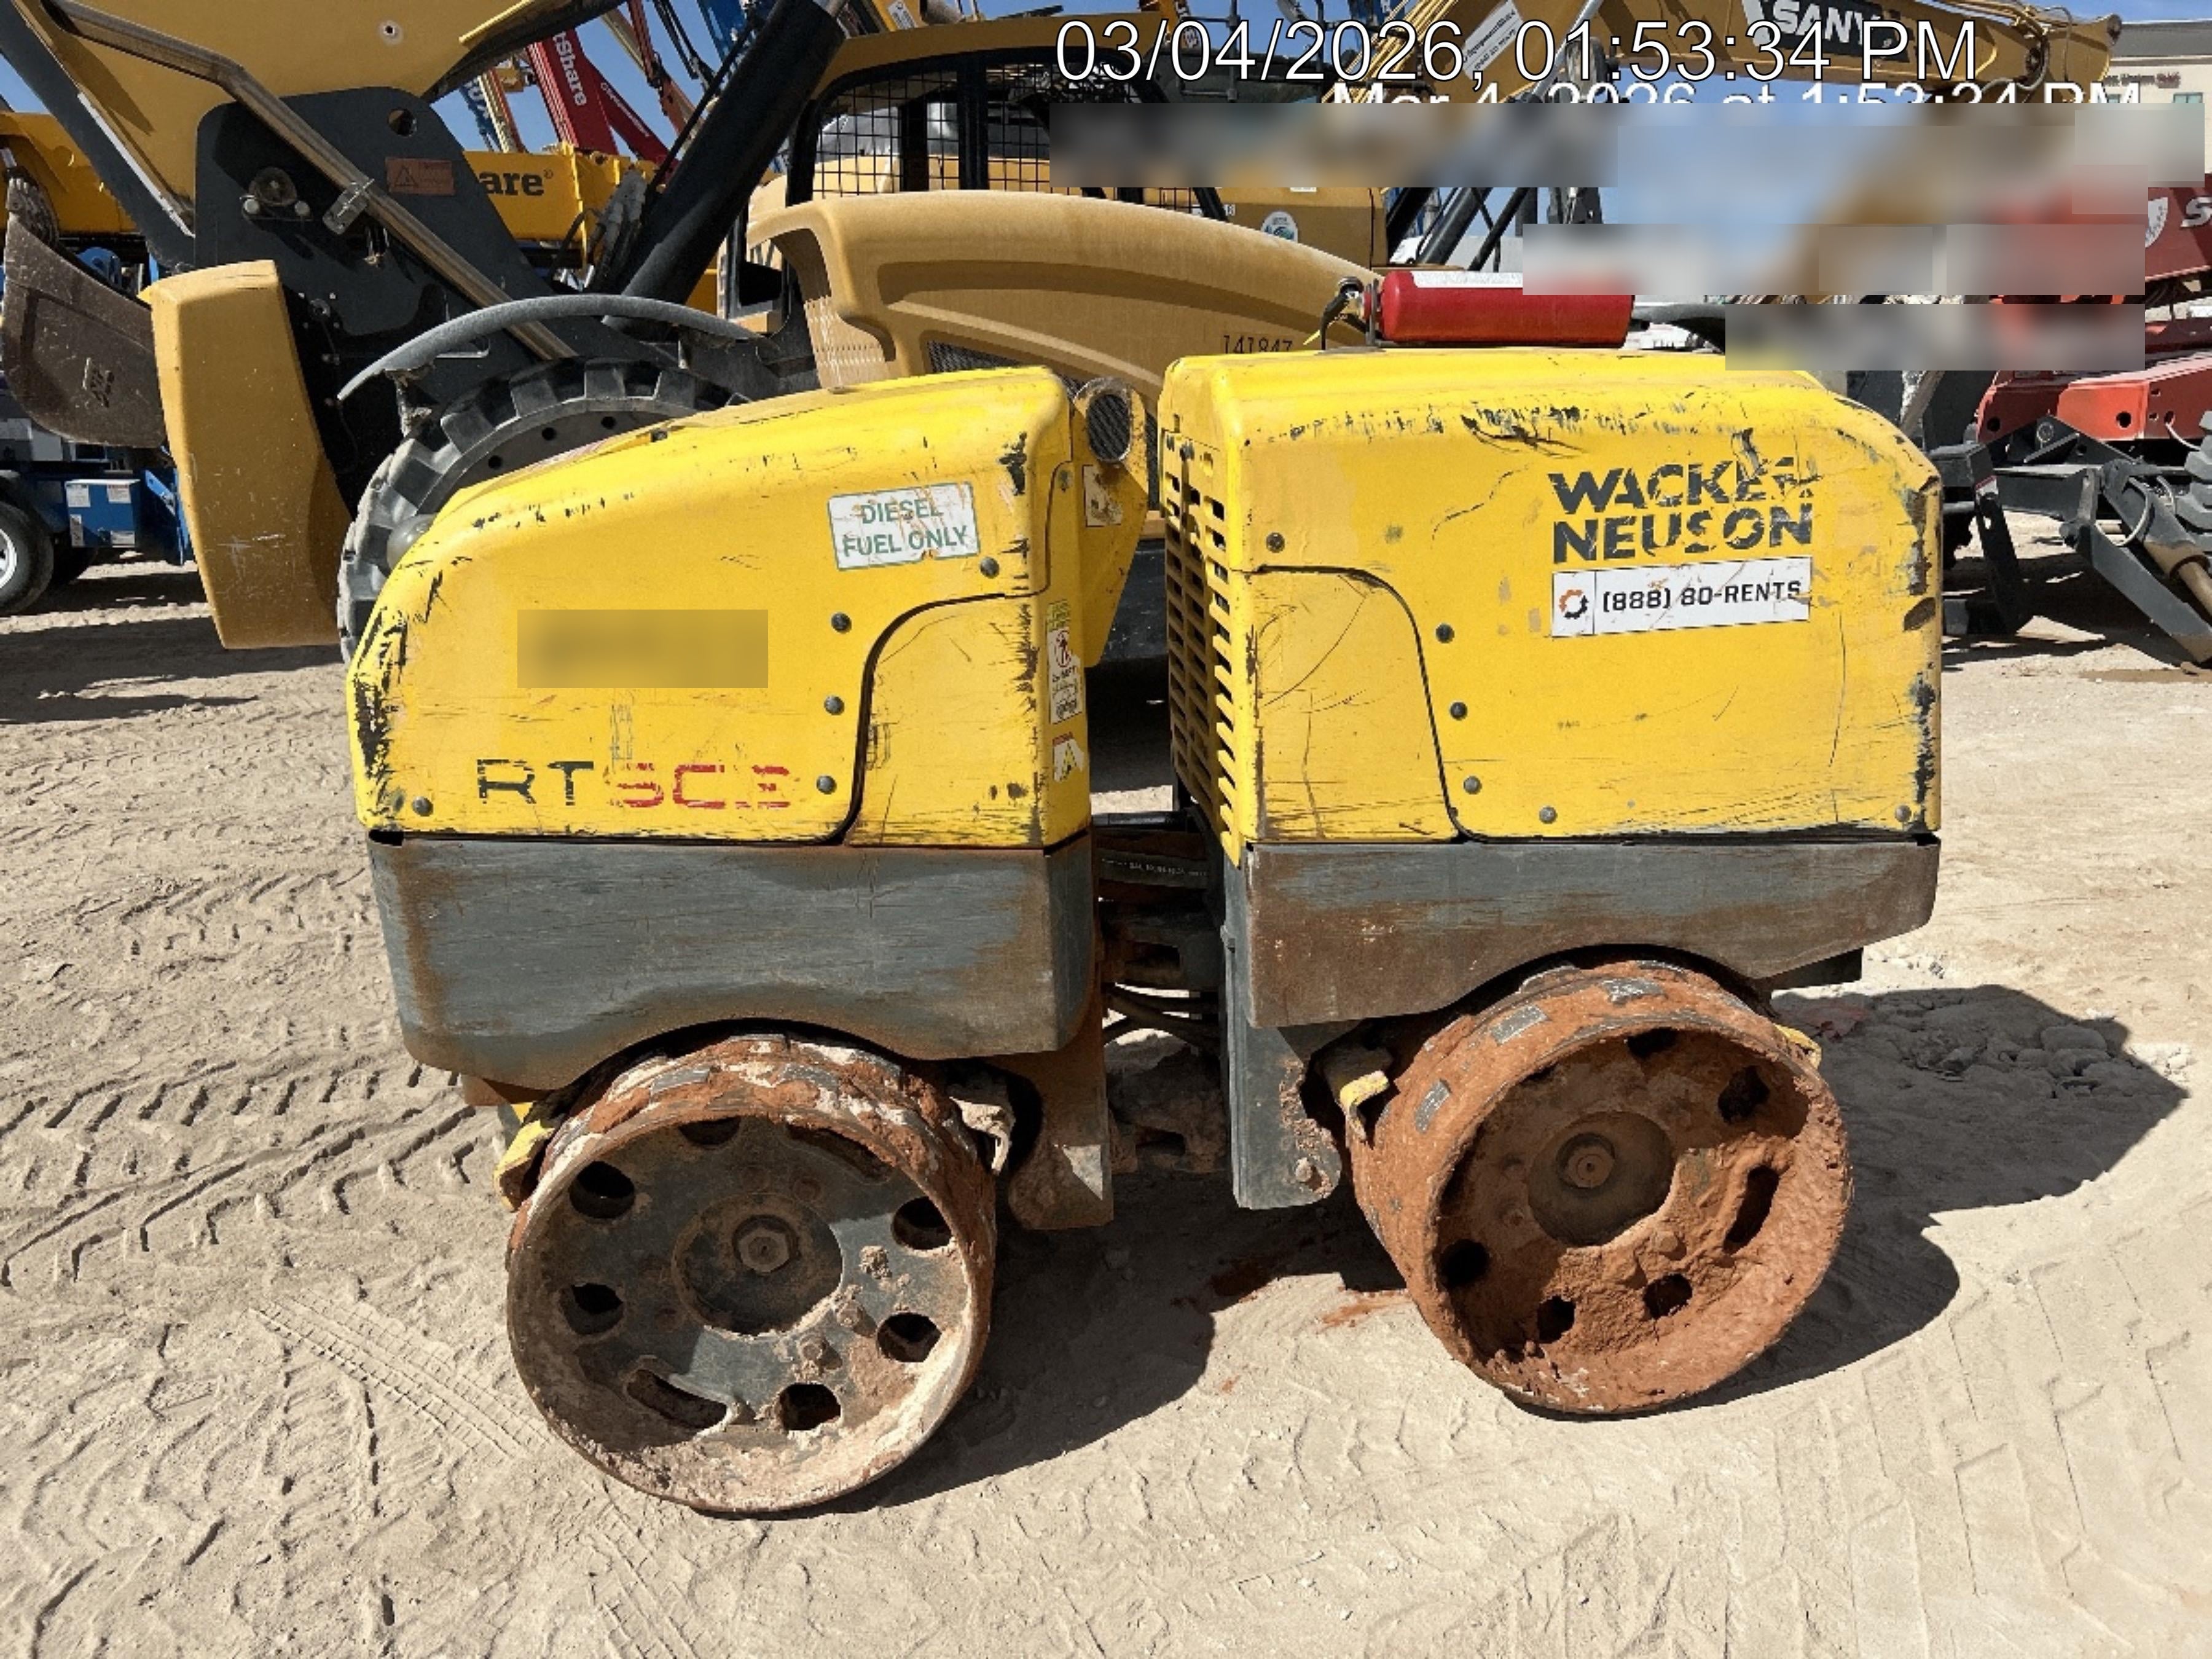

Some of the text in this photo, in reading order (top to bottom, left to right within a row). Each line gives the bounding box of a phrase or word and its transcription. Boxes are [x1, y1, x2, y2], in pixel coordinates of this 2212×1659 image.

[861, 498, 943, 524] DIESEL
[842, 525, 967, 557] FUEL ONLY
[1553, 503, 1812, 563] NEUSON
[1602, 581, 1801, 613] (888) 80-RENTS
